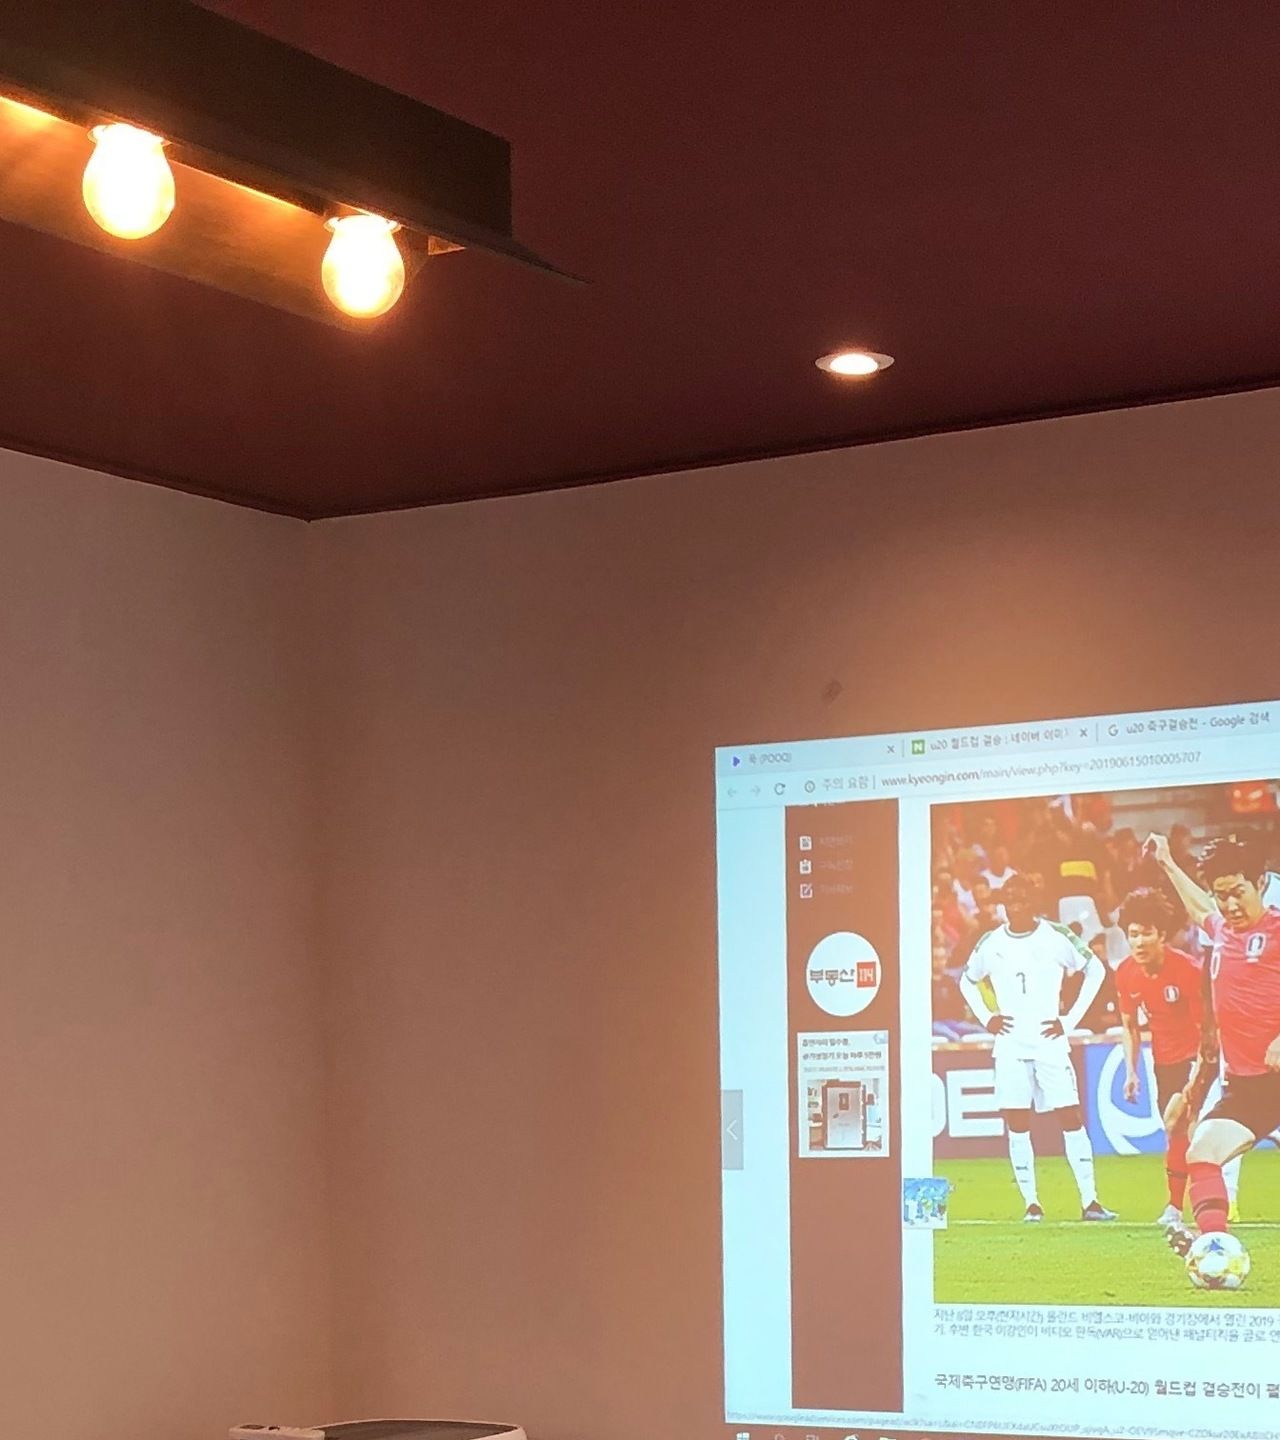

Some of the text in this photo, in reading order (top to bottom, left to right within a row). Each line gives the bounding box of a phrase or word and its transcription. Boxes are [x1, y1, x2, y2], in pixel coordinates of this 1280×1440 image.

[1210, 714, 1245, 729] Google
[1249, 711, 1270, 725] 검색
[809, 969, 855, 986] 부동산
[1248, 1314, 1275, 1328] 2019
[934, 1373, 1048, 1393] 국제축구연맹(FIFA)
[1050, 1377, 1079, 1393] 20세
[1083, 1377, 1150, 1397] 이하(U-20)
[1154, 1379, 1197, 1397] 월드컵
[1202, 1381, 1261, 1399] 결승전이
